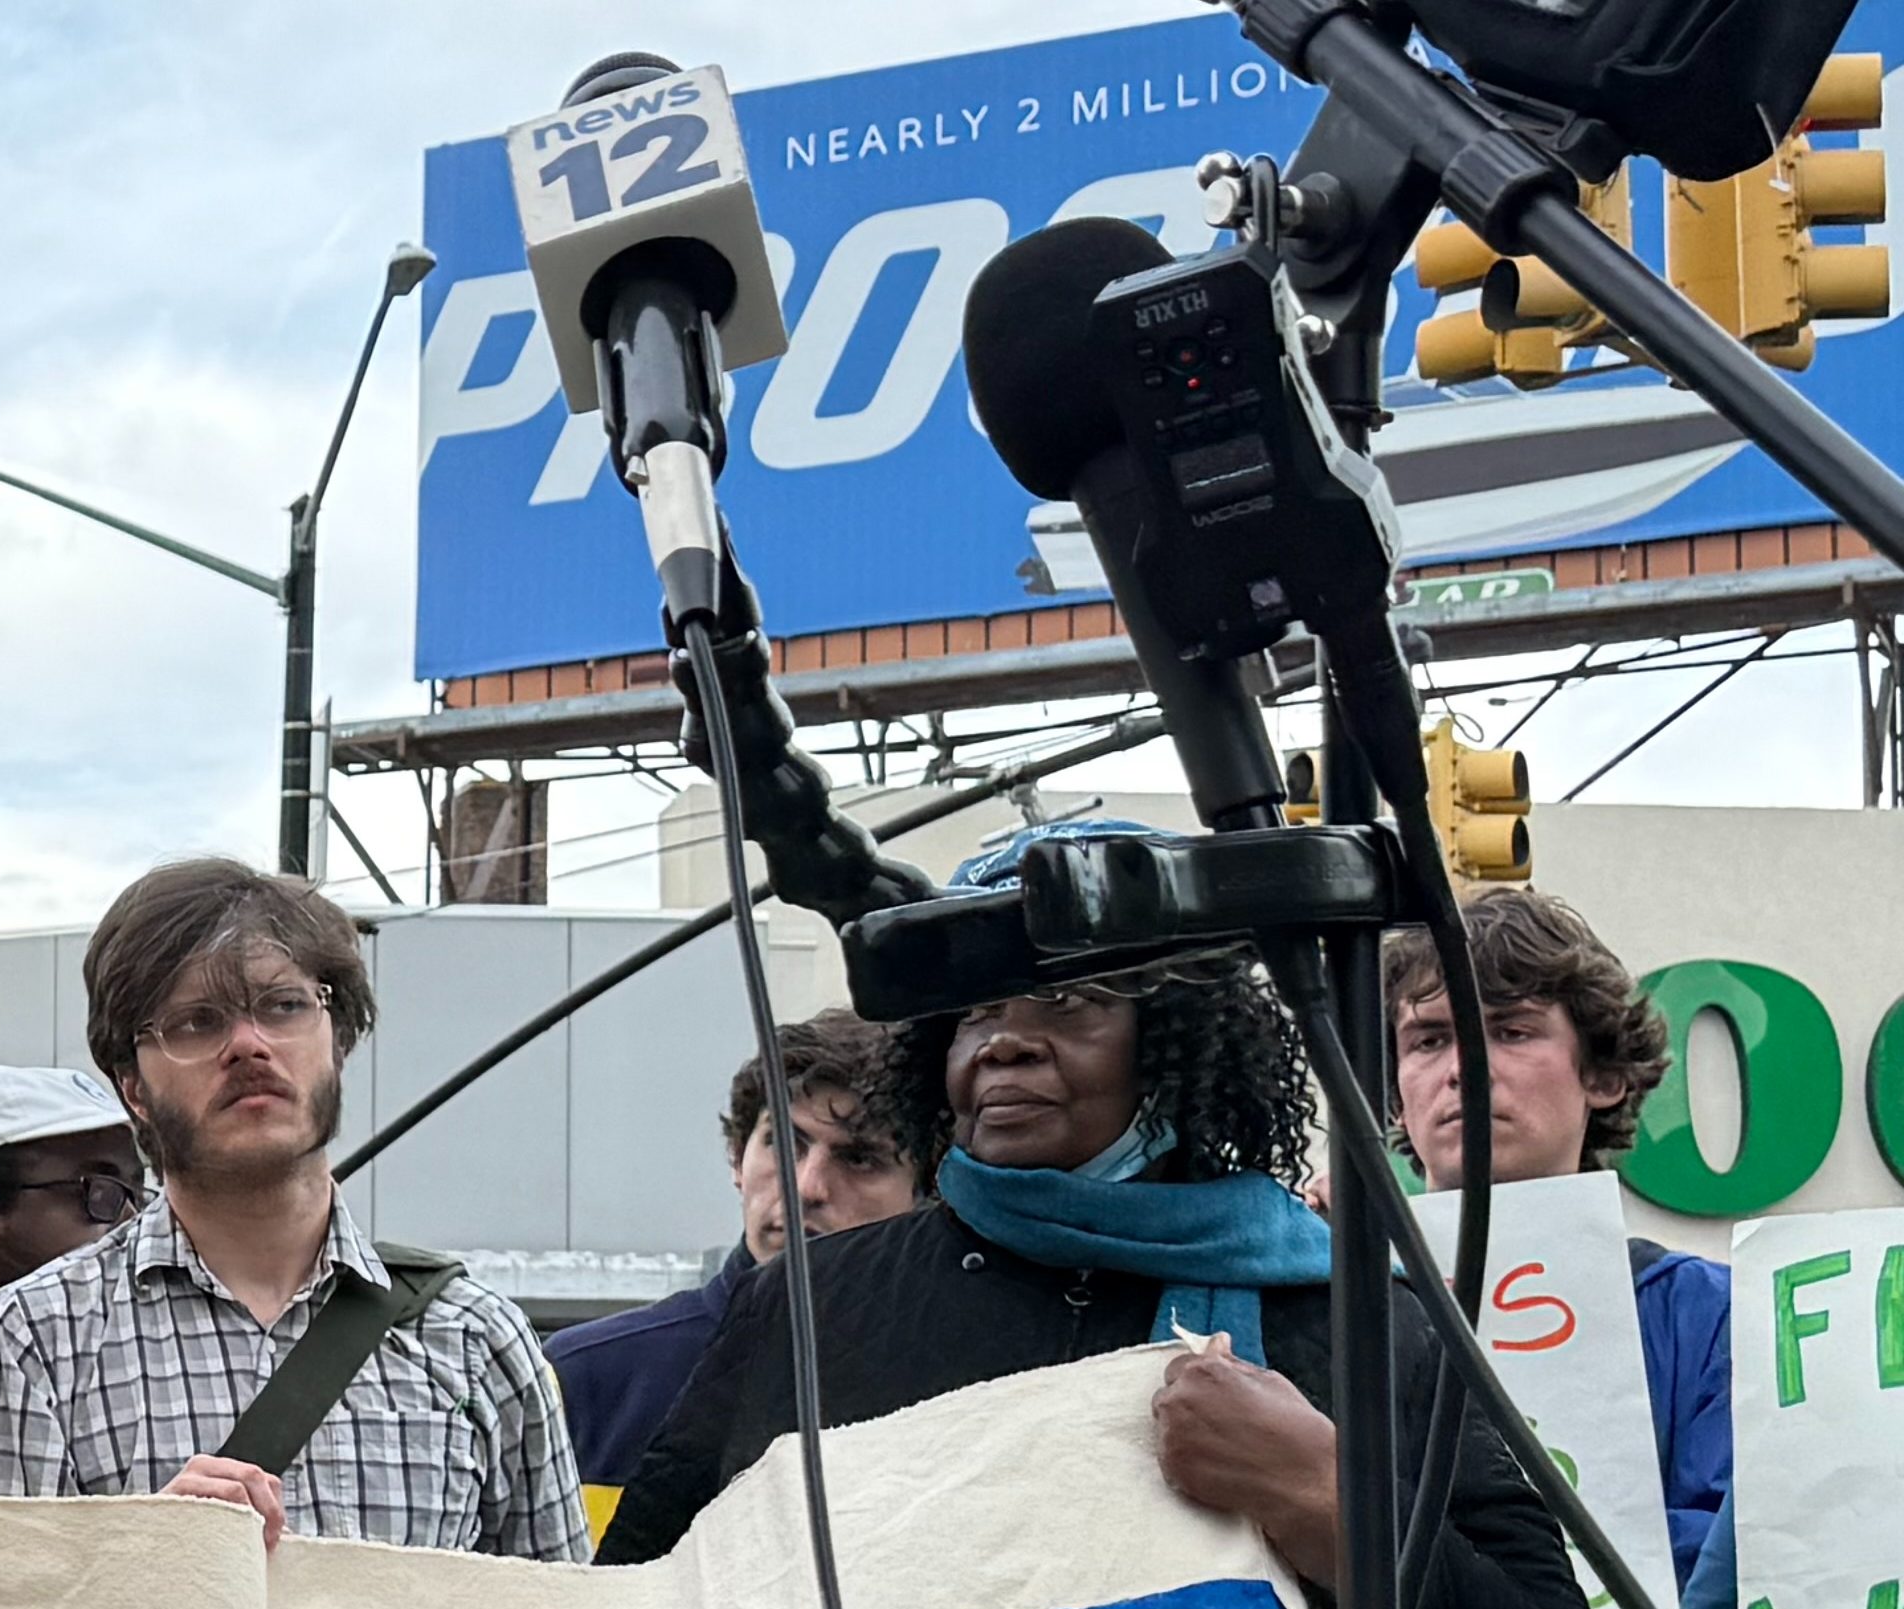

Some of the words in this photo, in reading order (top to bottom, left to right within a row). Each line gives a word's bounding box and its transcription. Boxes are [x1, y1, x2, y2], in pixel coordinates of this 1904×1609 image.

[532, 81, 701, 151] news
[785, 104, 989, 171] NEARLY
[1017, 98, 1040, 133] 2
[538, 114, 722, 222] 12
